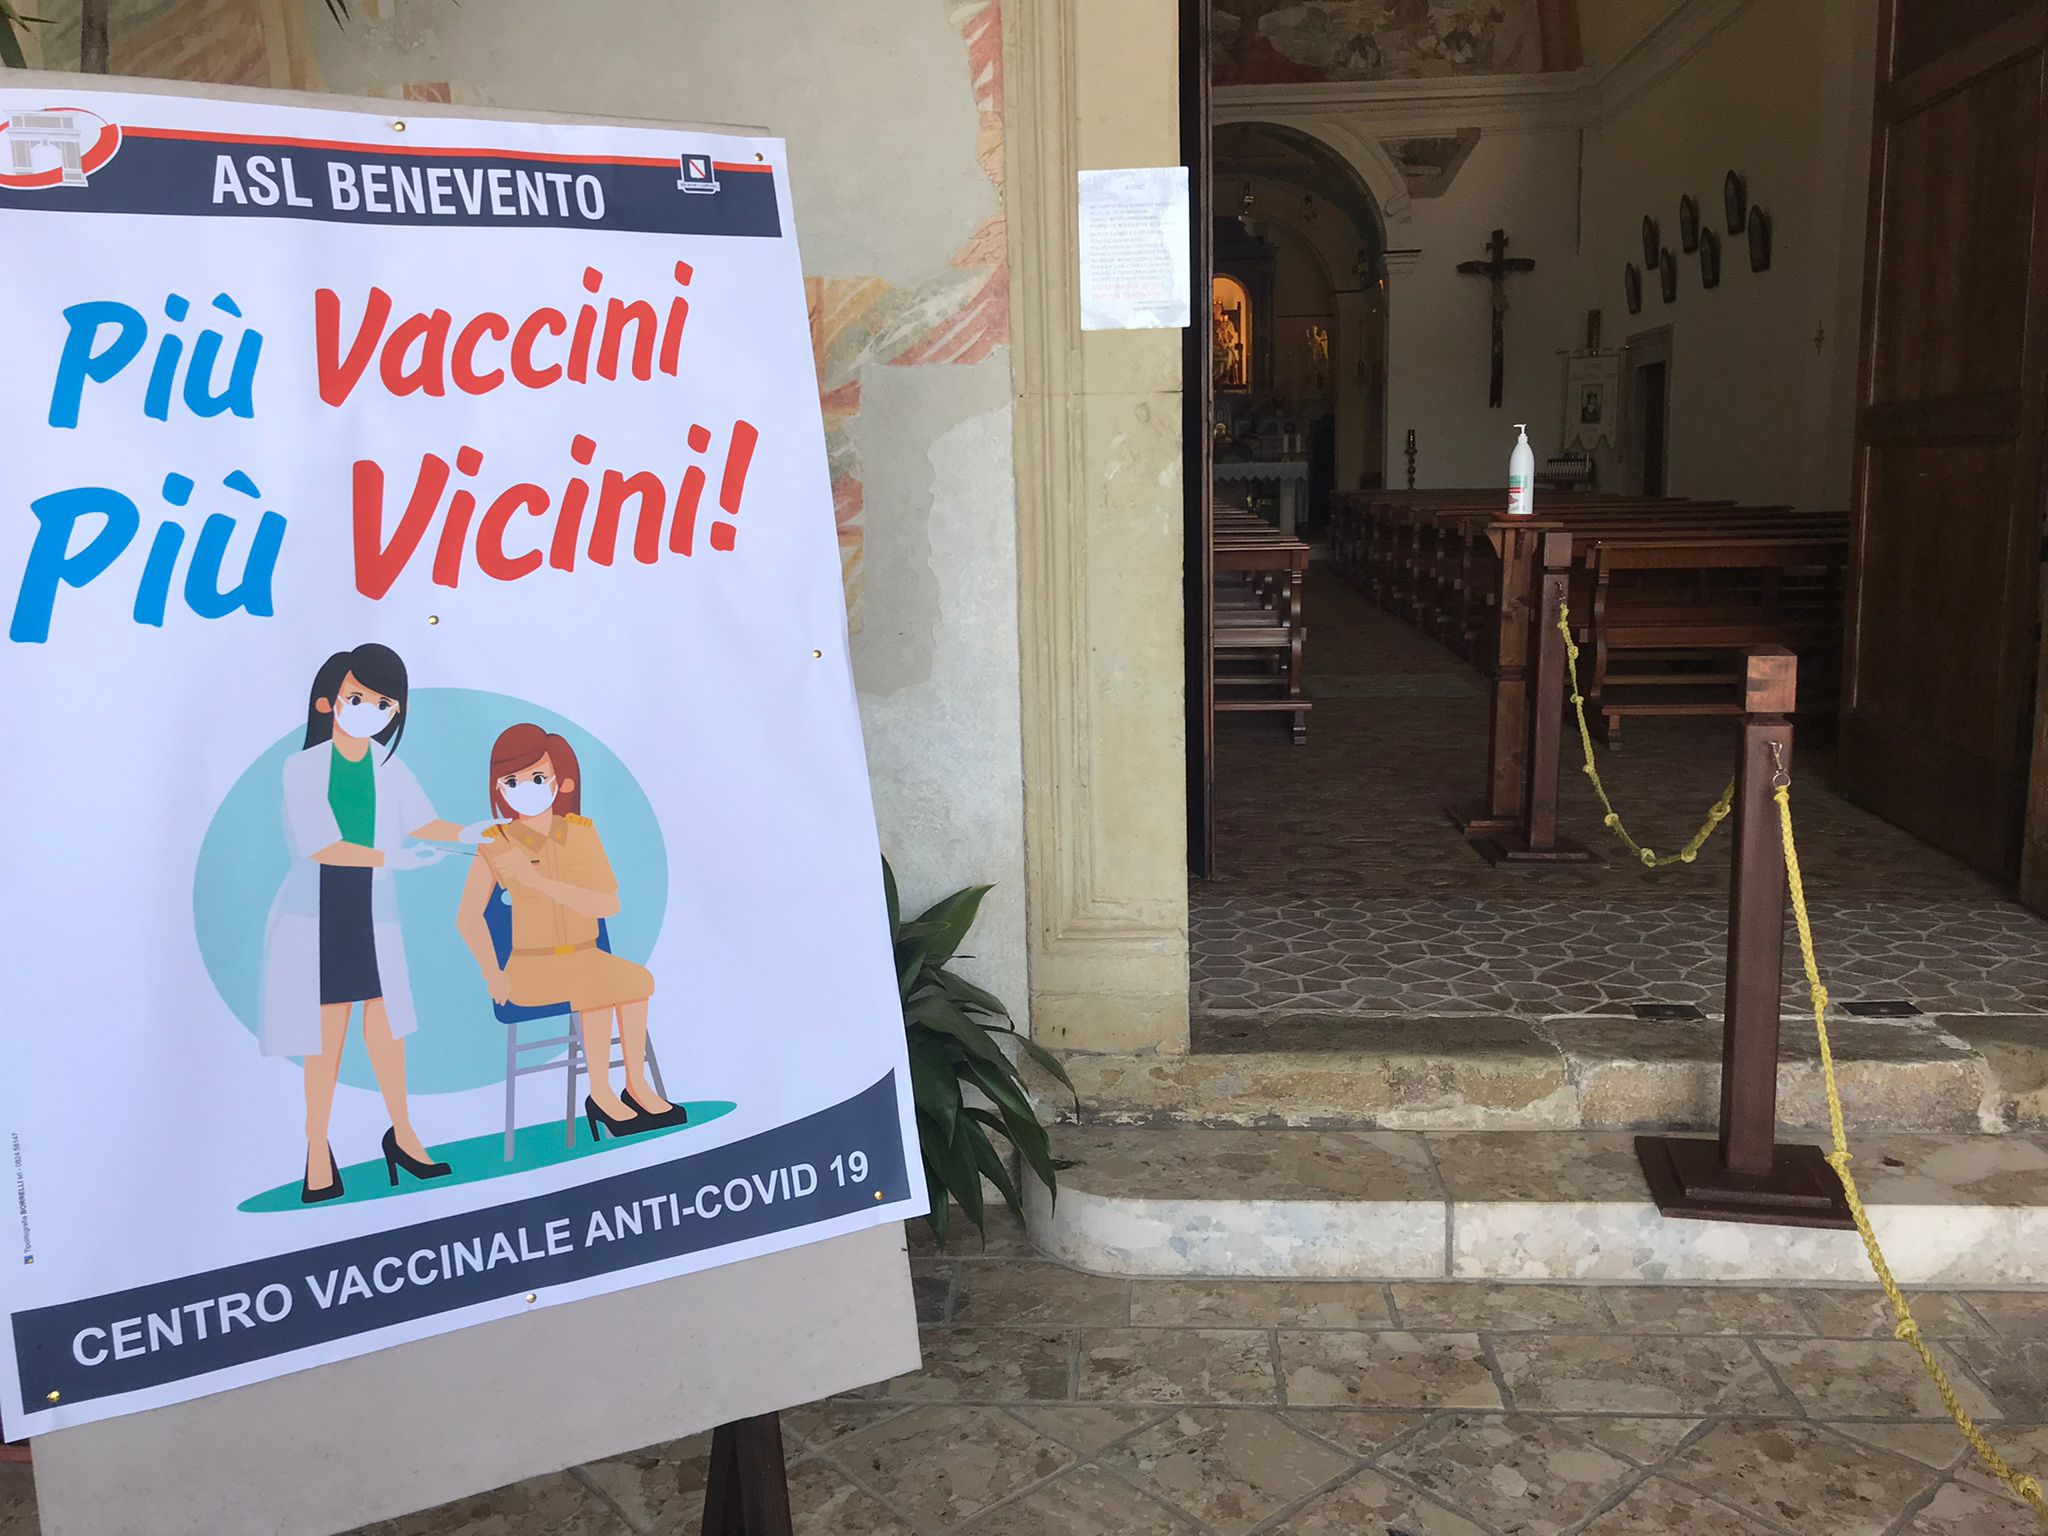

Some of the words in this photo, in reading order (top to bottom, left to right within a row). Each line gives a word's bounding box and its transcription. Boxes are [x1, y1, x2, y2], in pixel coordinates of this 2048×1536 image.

[212, 154, 314, 208] ASL
[327, 161, 606, 220] BENEVENTO
[49, 293, 264, 429] Più
[314, 260, 694, 407] Vaccini
[9, 470, 288, 644] Più
[352, 420, 759, 601] Vicini!
[17, 1181, 27, 1215] BORRELLI
[72, 1283, 293, 1366] CENTRO
[305, 1217, 574, 1309] VACCINALE
[584, 1163, 818, 1248] ANTI-COVID
[830, 1150, 870, 1187] 19
